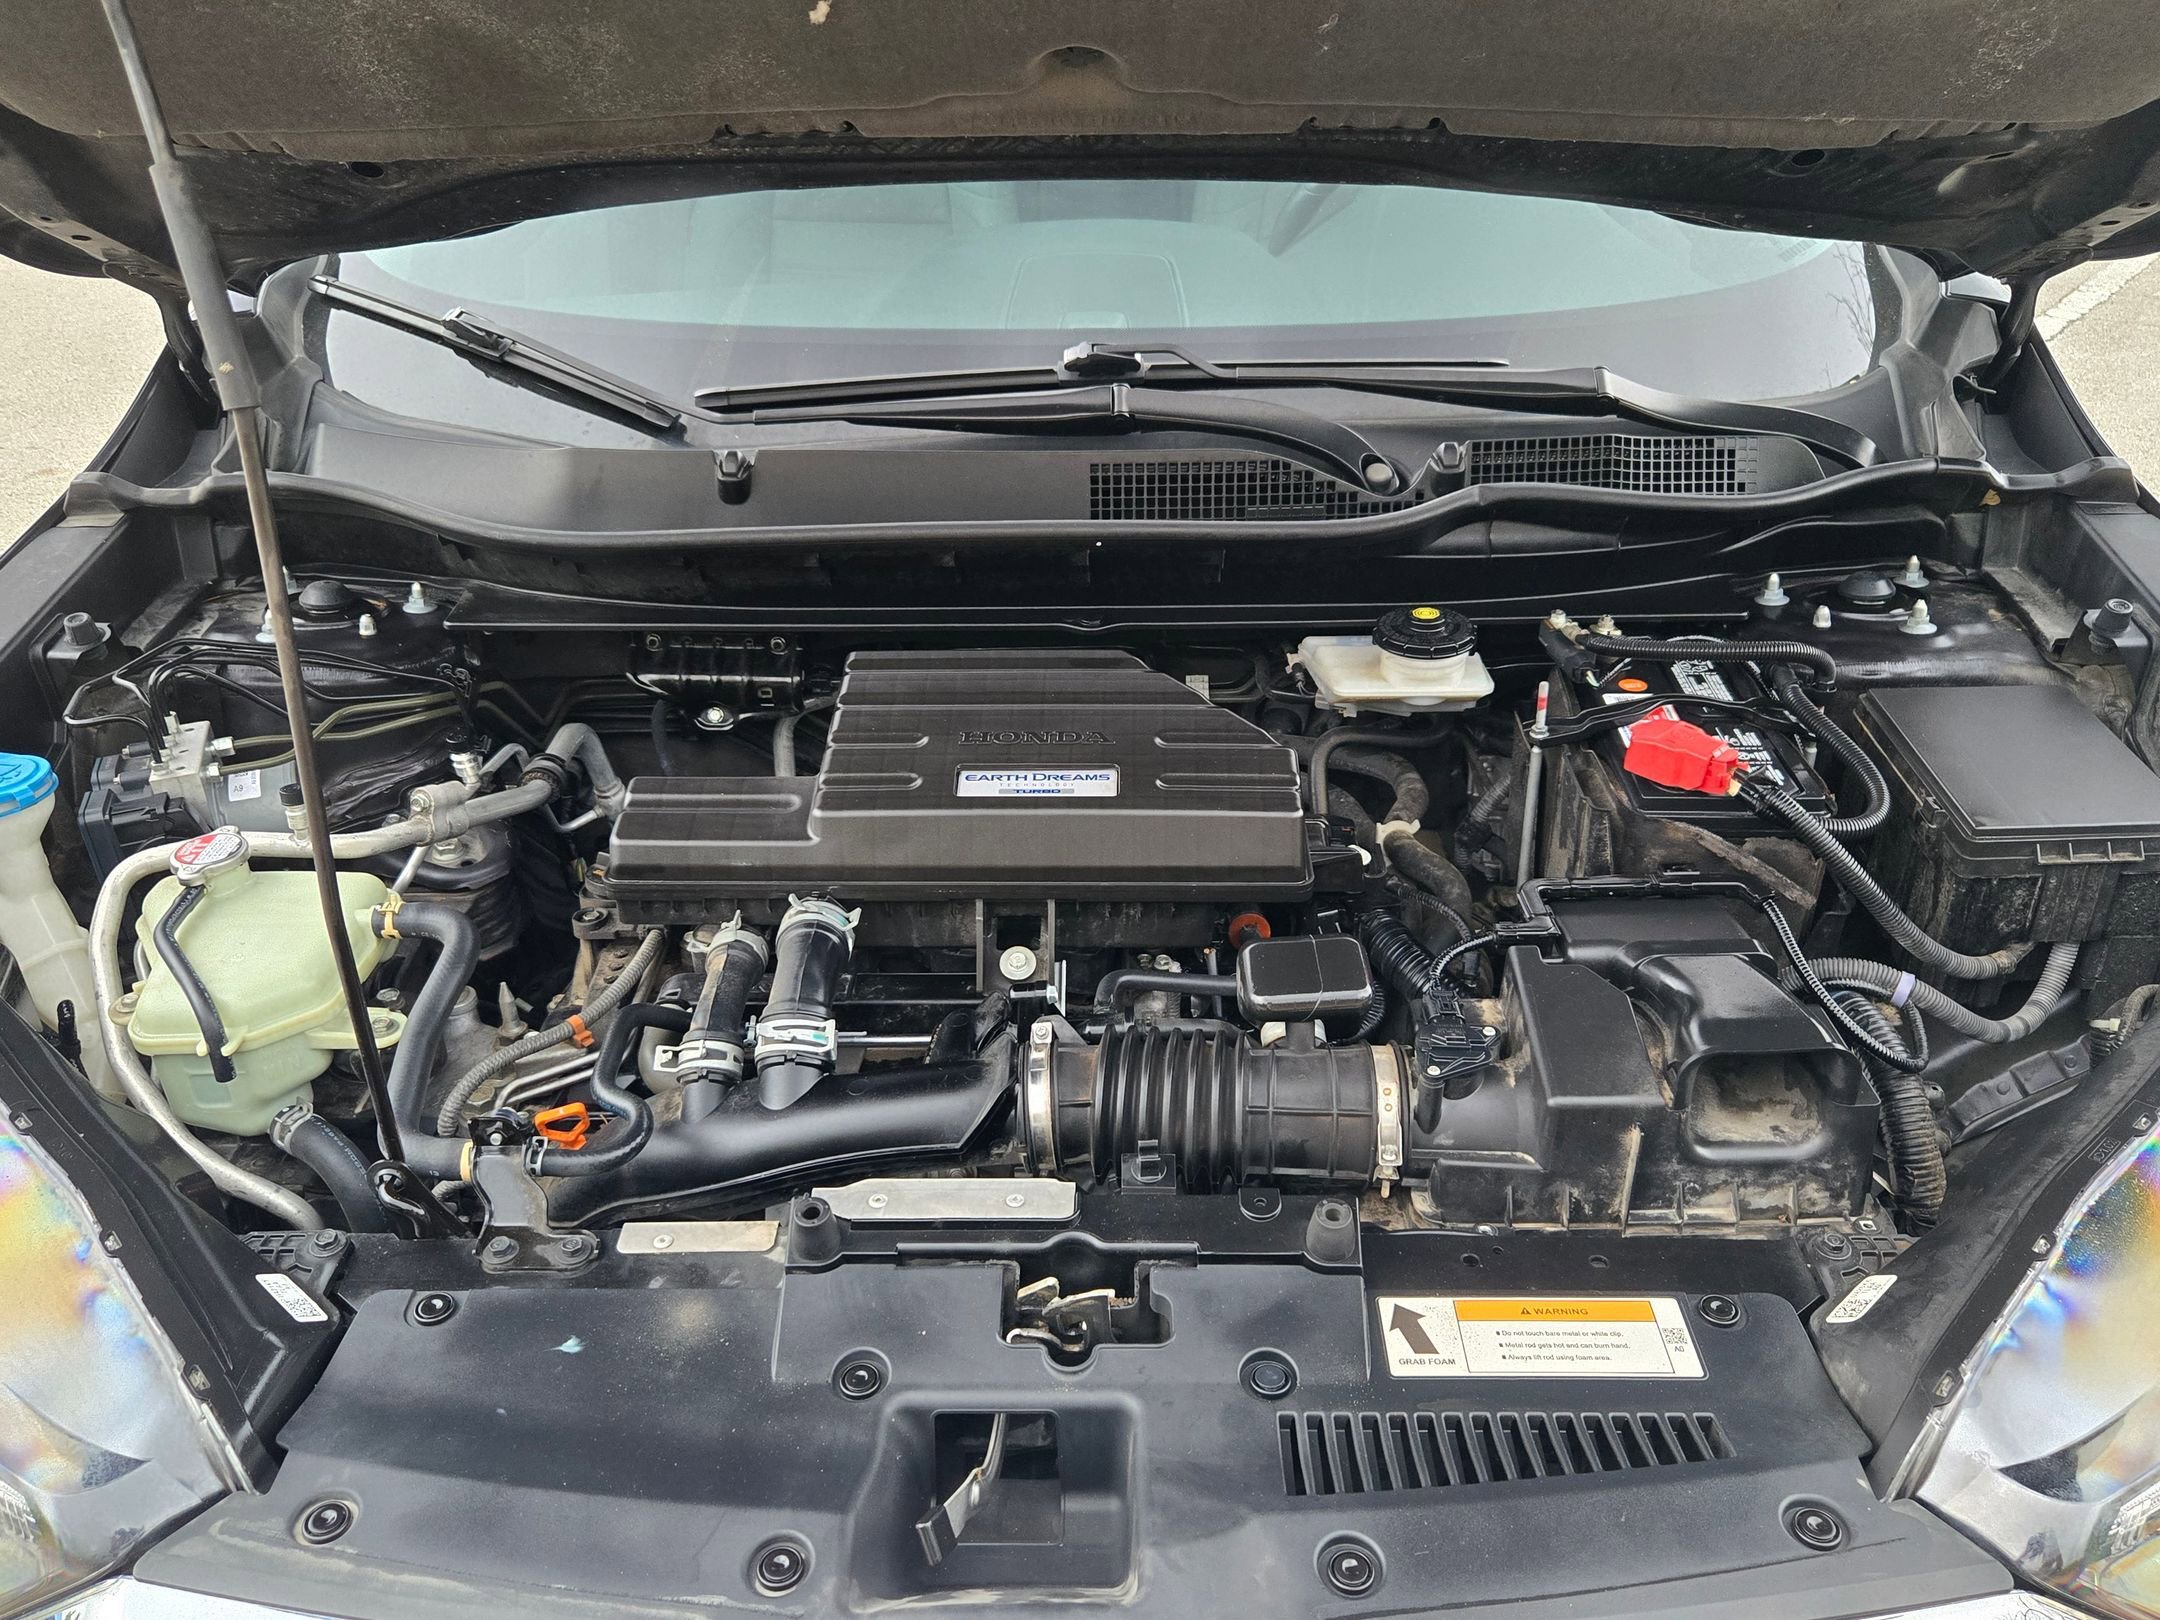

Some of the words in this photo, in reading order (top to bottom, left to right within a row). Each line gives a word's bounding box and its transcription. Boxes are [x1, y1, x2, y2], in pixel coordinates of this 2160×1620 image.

[958, 731, 1116, 745] HONDA
[965, 774, 1028, 782] EARTH
[1032, 773, 1110, 782] DREAMS
[1537, 1342, 1552, 1350] gets
[1508, 1354, 1532, 1362] Always
[1556, 1354, 1575, 1362] using
